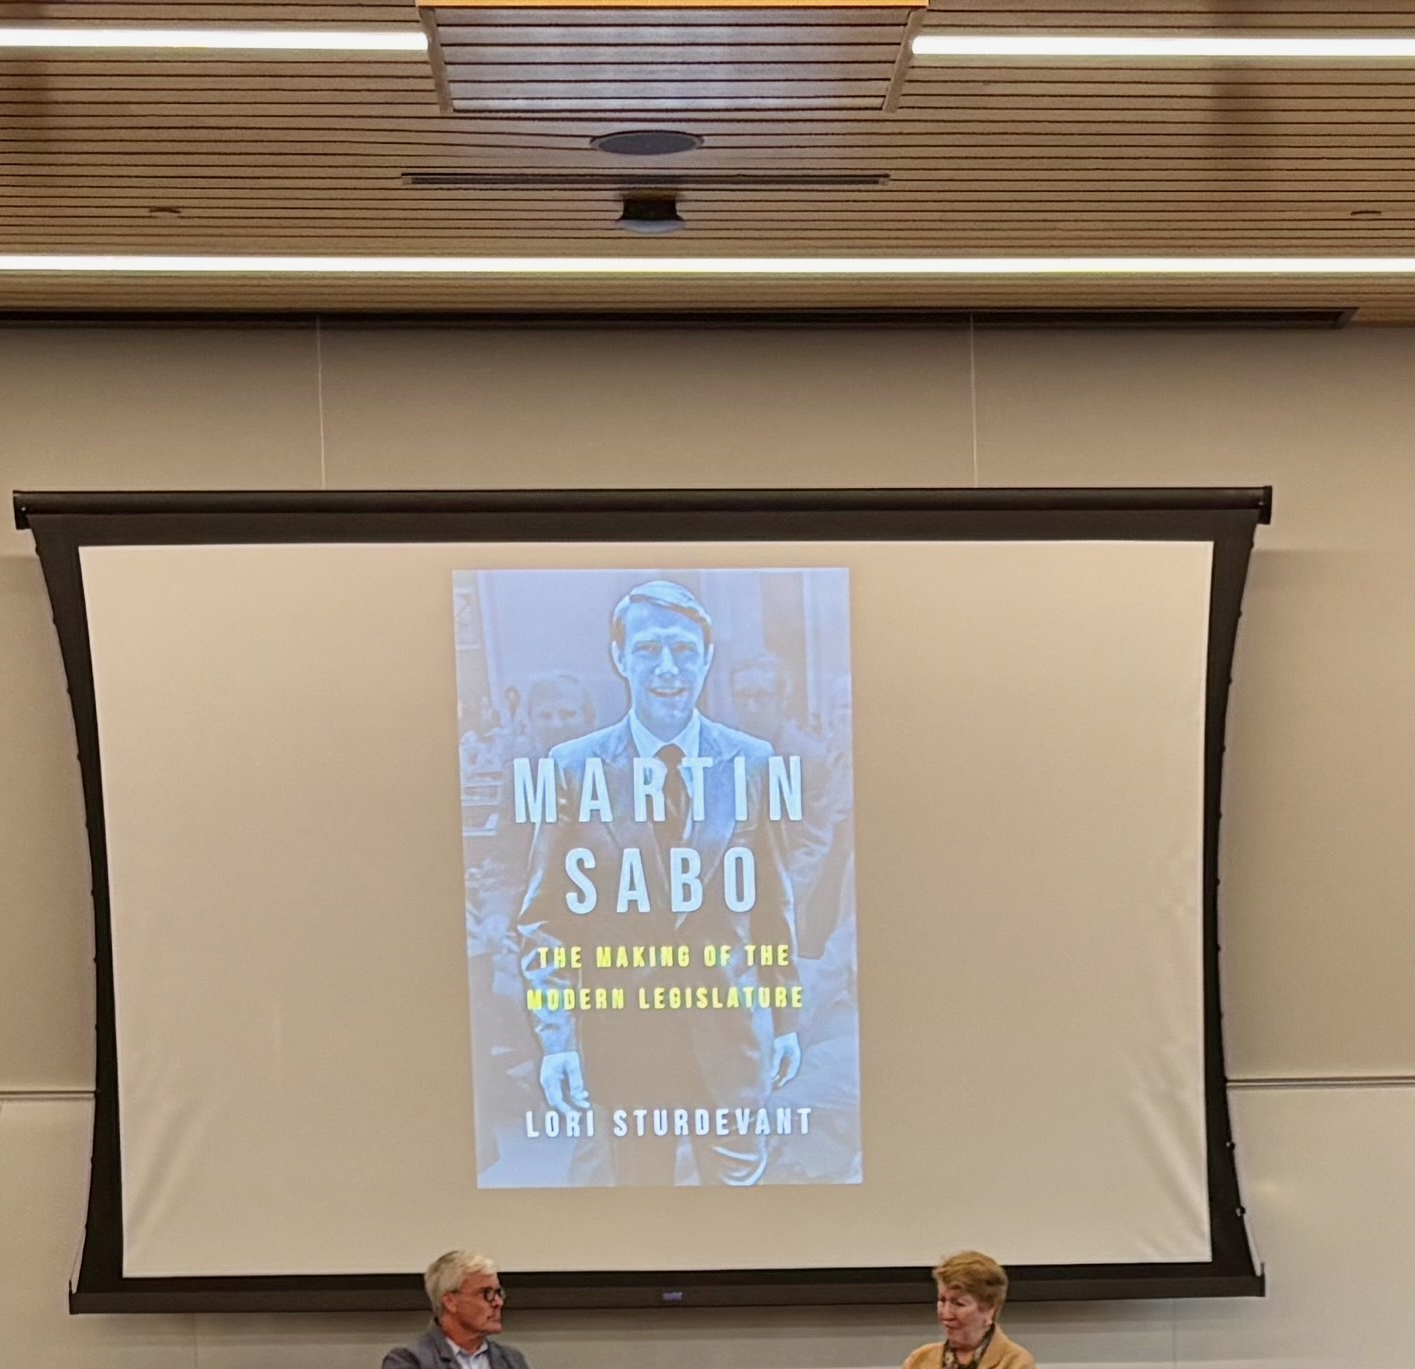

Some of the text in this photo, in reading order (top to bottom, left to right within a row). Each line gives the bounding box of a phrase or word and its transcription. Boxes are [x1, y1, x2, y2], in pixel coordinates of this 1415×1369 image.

[513, 755, 803, 823] MARTIN
[565, 846, 756, 914] SABO
[537, 944, 789, 969] THE MAKING OF THE
[526, 986, 803, 1011] MODERN LEGISLATURE
[525, 1107, 811, 1138] LORI STURDEVANT
